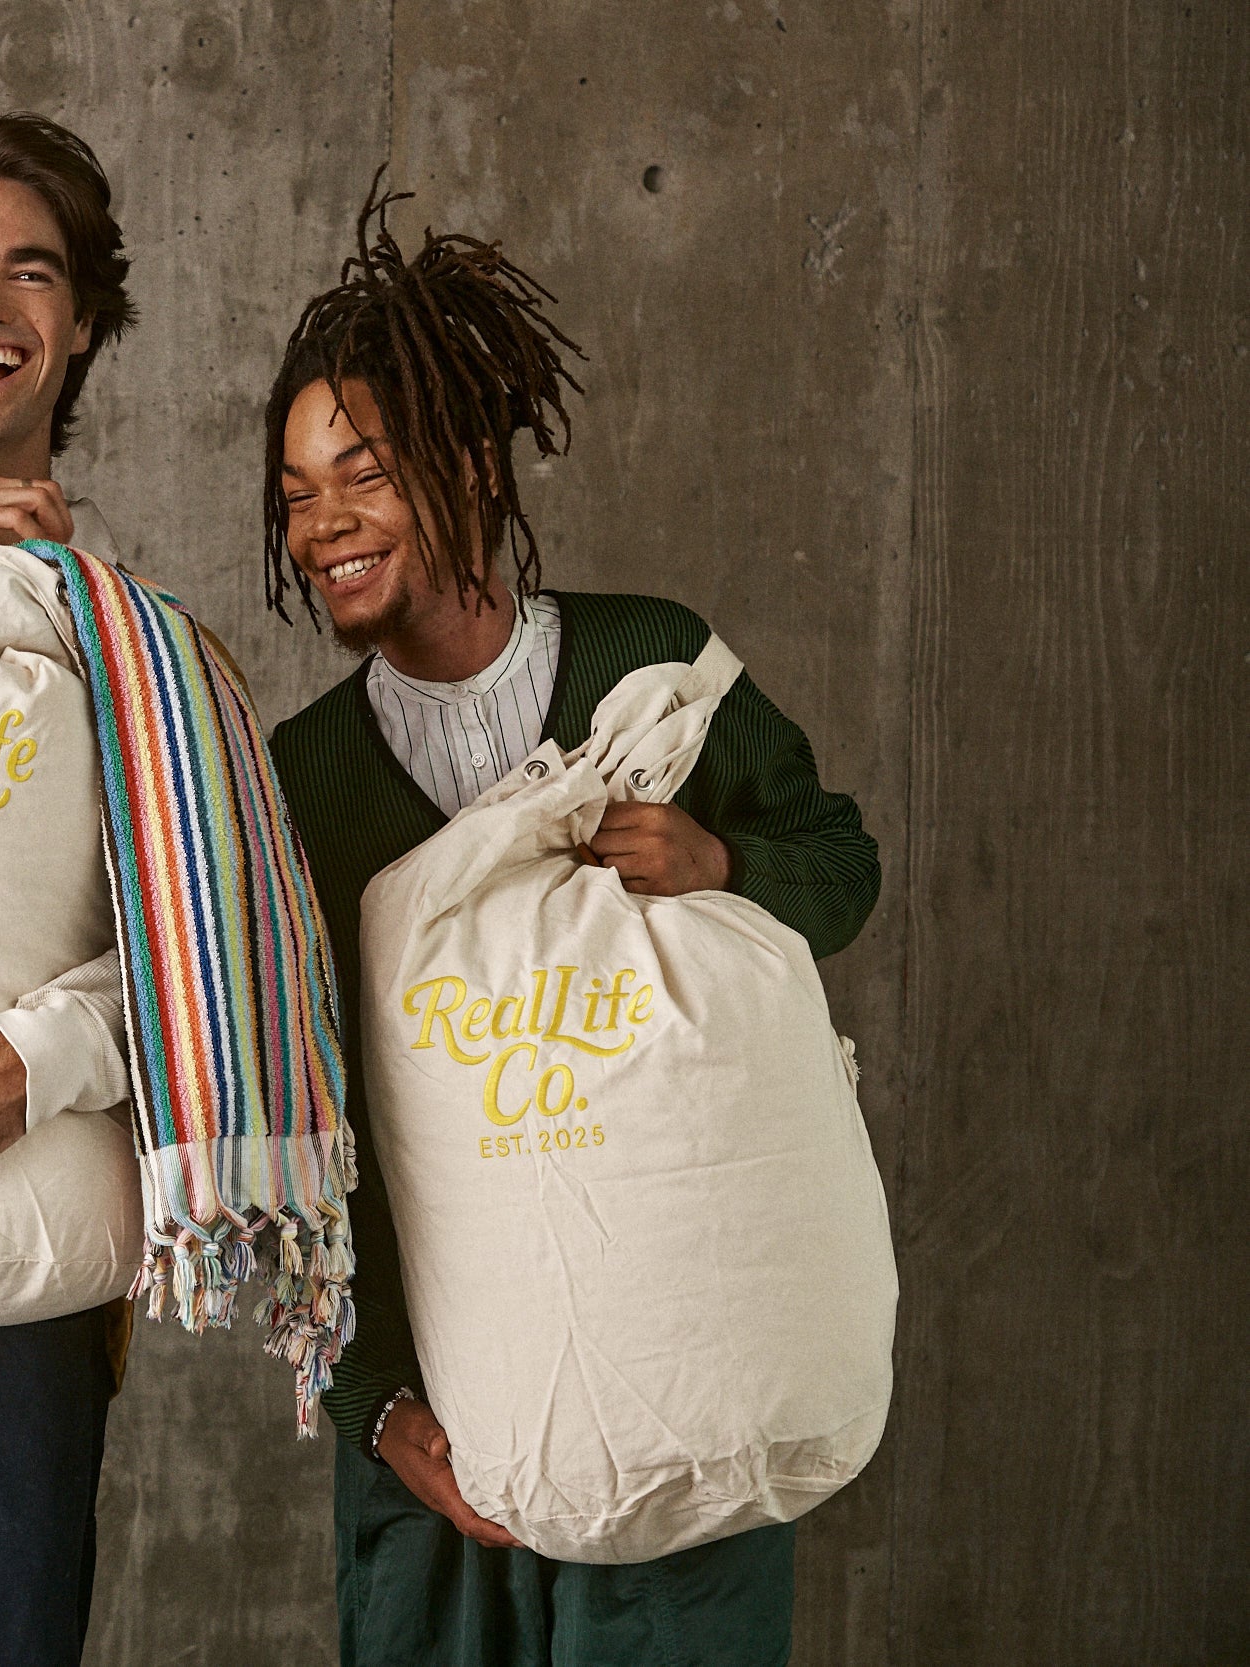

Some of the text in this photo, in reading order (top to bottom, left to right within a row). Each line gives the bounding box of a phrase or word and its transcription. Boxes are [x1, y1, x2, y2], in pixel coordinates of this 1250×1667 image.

[483, 1042, 589, 1127] Co.
[479, 1123, 606, 1159] EST. 2025
